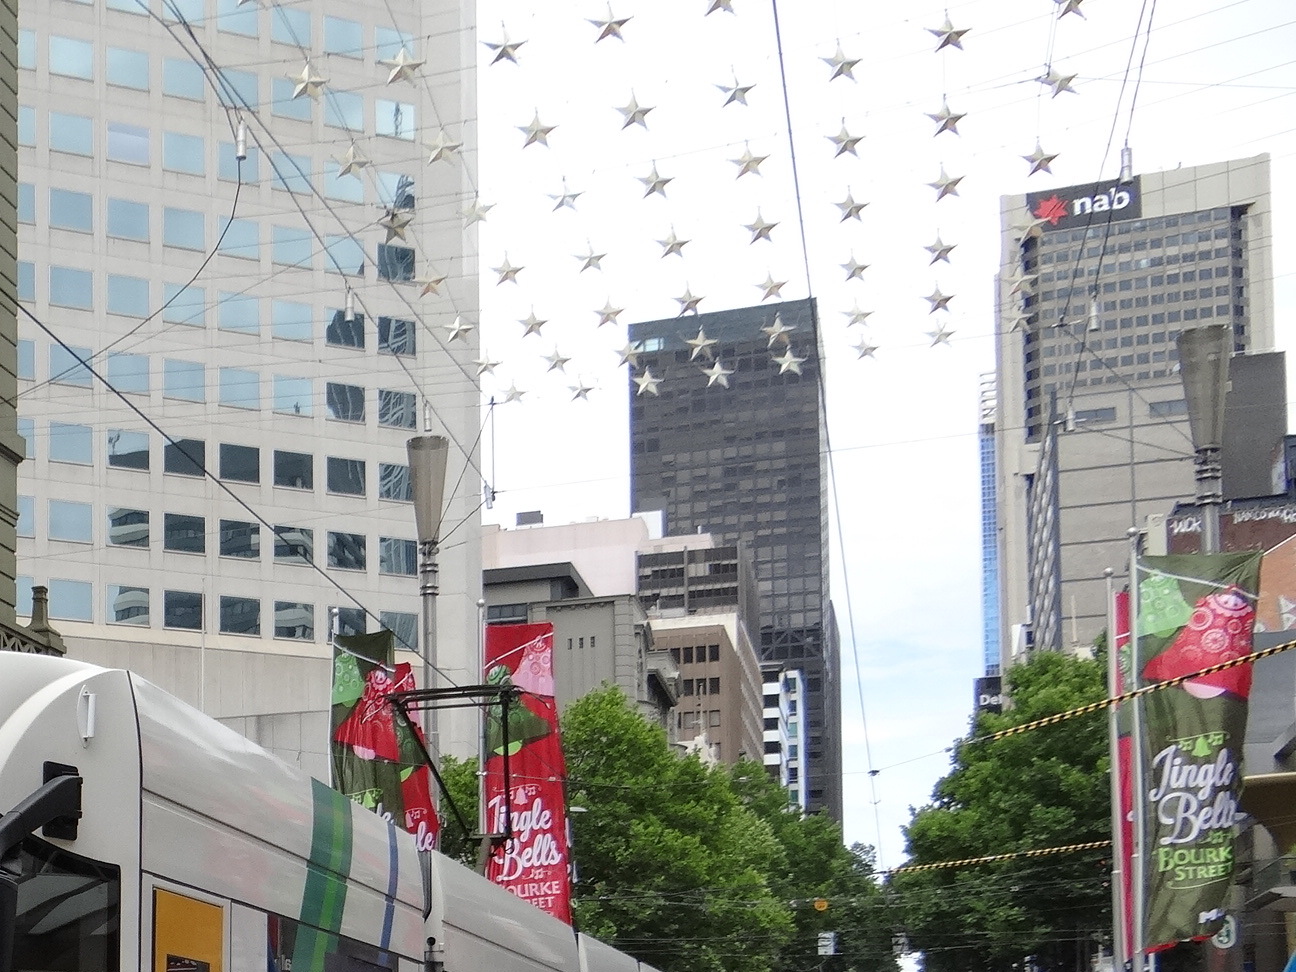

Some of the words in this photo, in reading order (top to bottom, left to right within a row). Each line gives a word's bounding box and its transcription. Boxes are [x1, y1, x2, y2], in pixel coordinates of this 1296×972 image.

[1072, 187, 1131, 217] nab
[492, 833, 563, 881] Bells
[1156, 846, 1233, 873] BOURK
[1174, 861, 1234, 882] STREET
